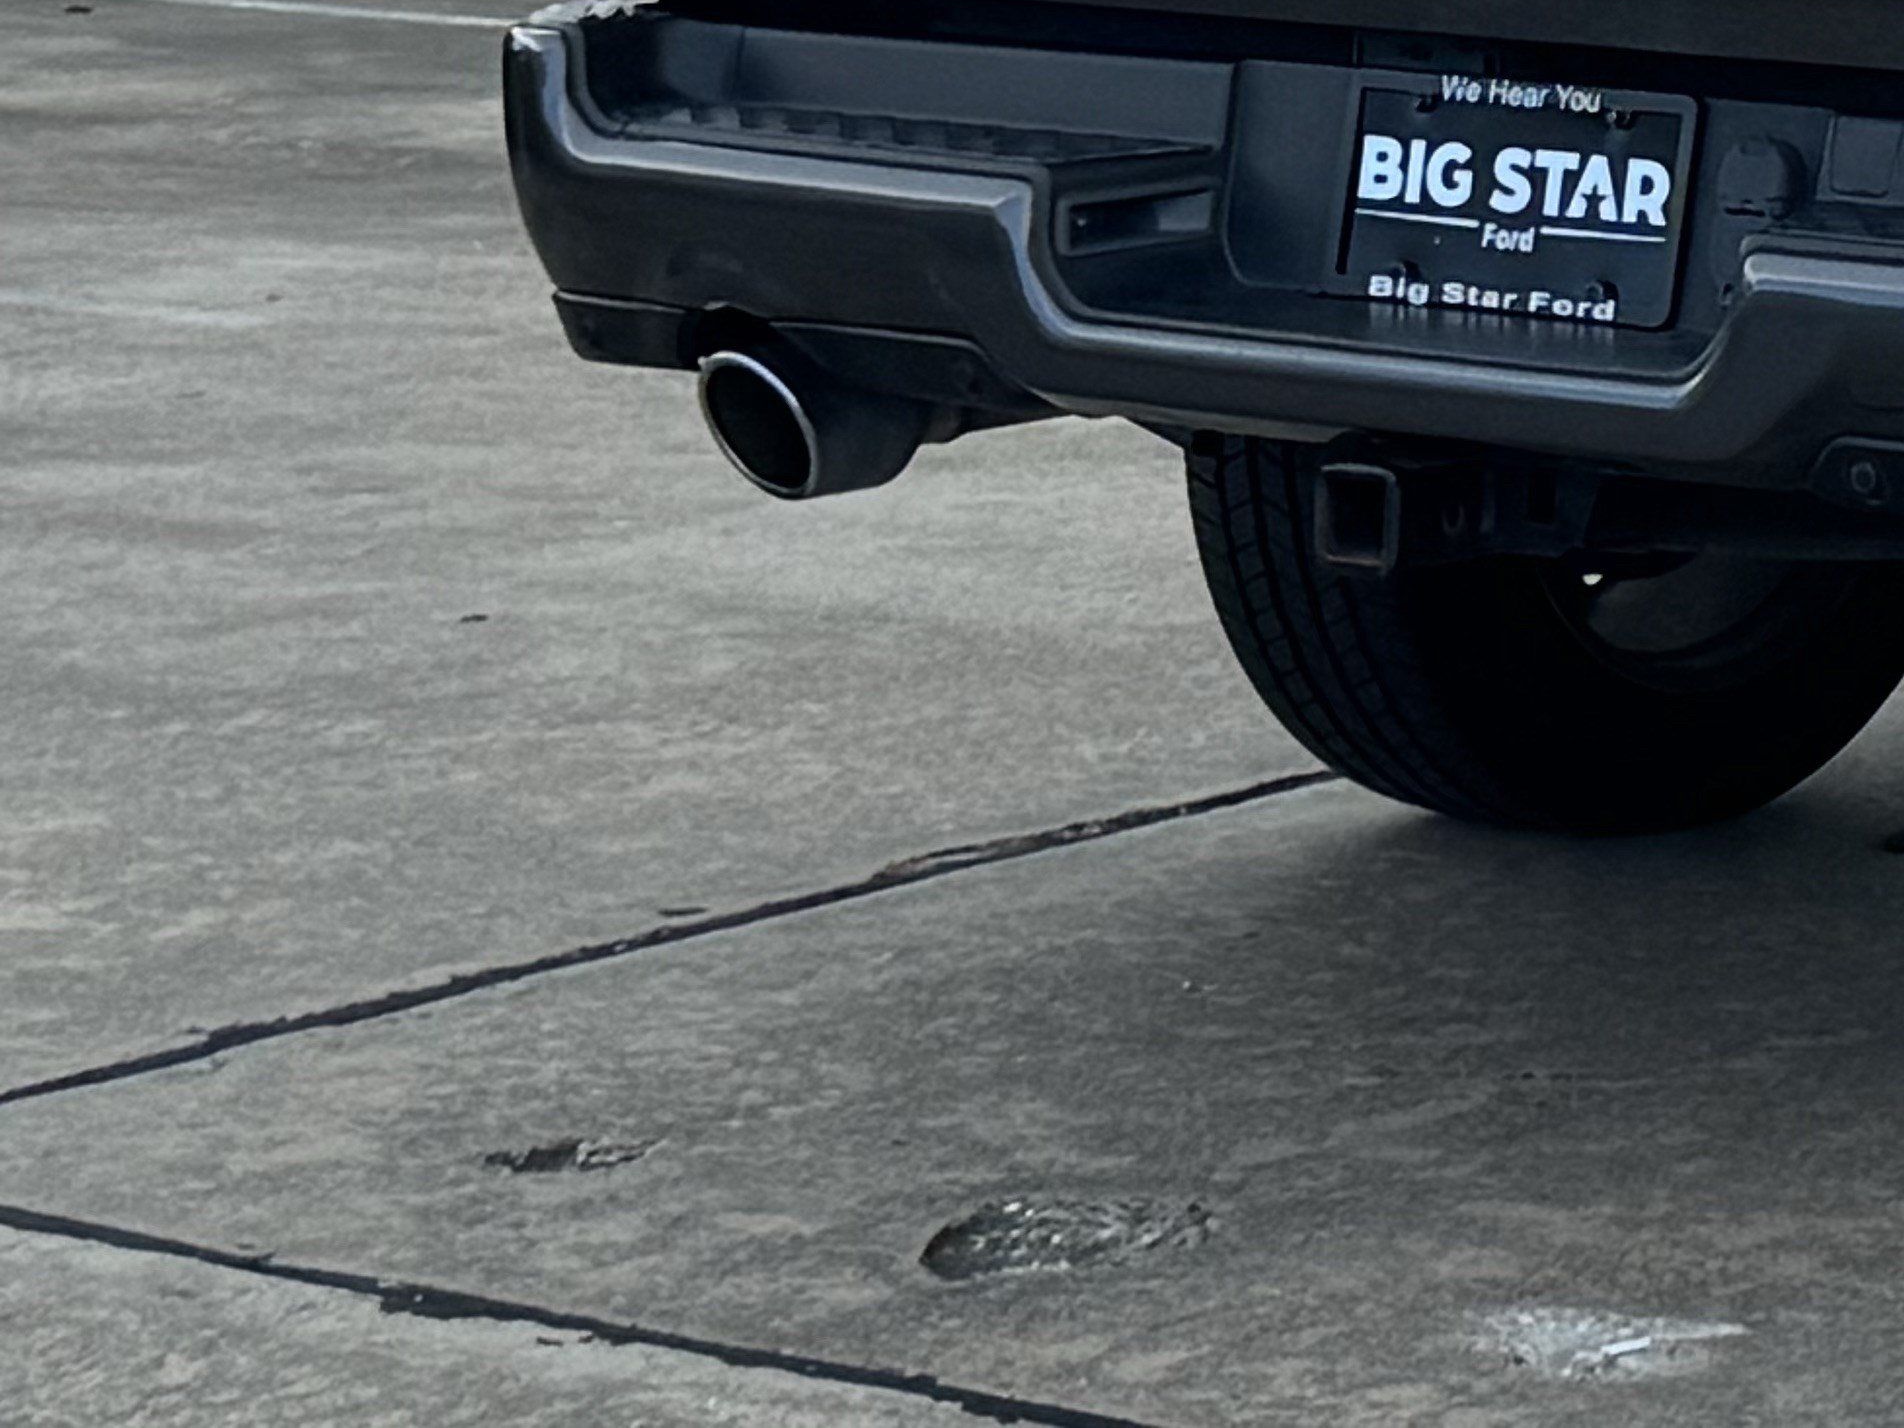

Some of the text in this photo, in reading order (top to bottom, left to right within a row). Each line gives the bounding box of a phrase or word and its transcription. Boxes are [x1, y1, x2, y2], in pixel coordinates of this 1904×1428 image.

[1441, 74, 1602, 114] We Hear You
[1356, 134, 1671, 227] BIG STAR
[1481, 222, 1536, 253] Ford
[1367, 274, 1616, 322] Big Star Ford
